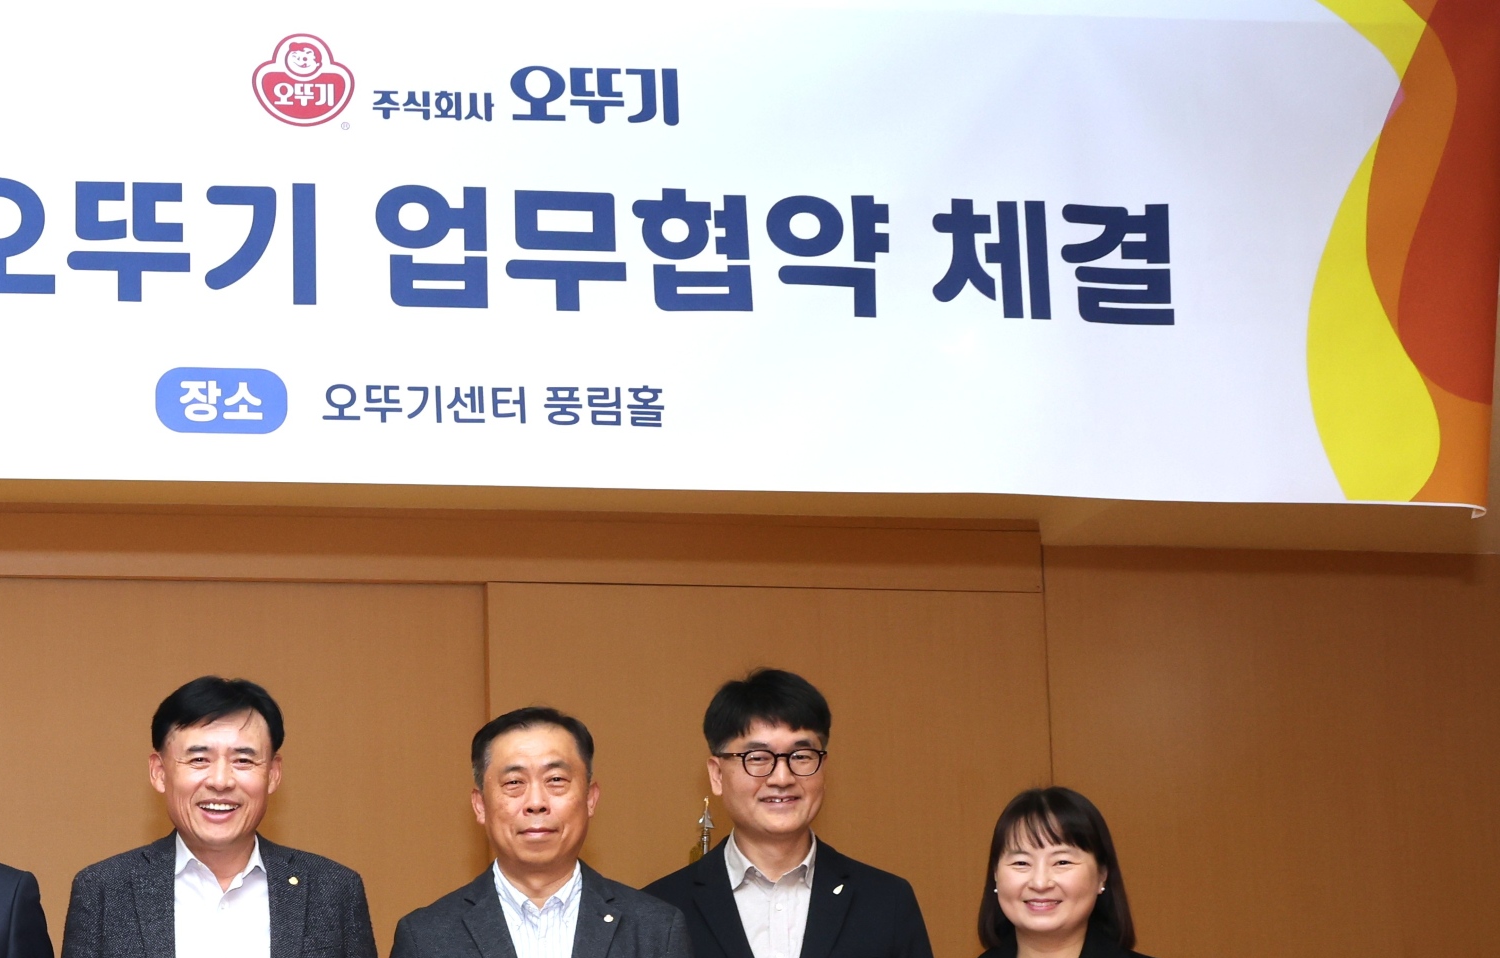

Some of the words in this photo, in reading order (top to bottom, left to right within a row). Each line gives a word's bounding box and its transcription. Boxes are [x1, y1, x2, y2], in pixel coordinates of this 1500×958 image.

[273, 82, 335, 107] 오뚜기
[372, 90, 495, 122] 주식회사
[509, 65, 680, 126] 오뚜기
[375, 184, 890, 318] 업무협약
[932, 198, 1175, 326] 체결
[179, 380, 263, 422] 장소
[321, 383, 527, 425] 오뚜기센터
[543, 384, 665, 428] 풍림홀
